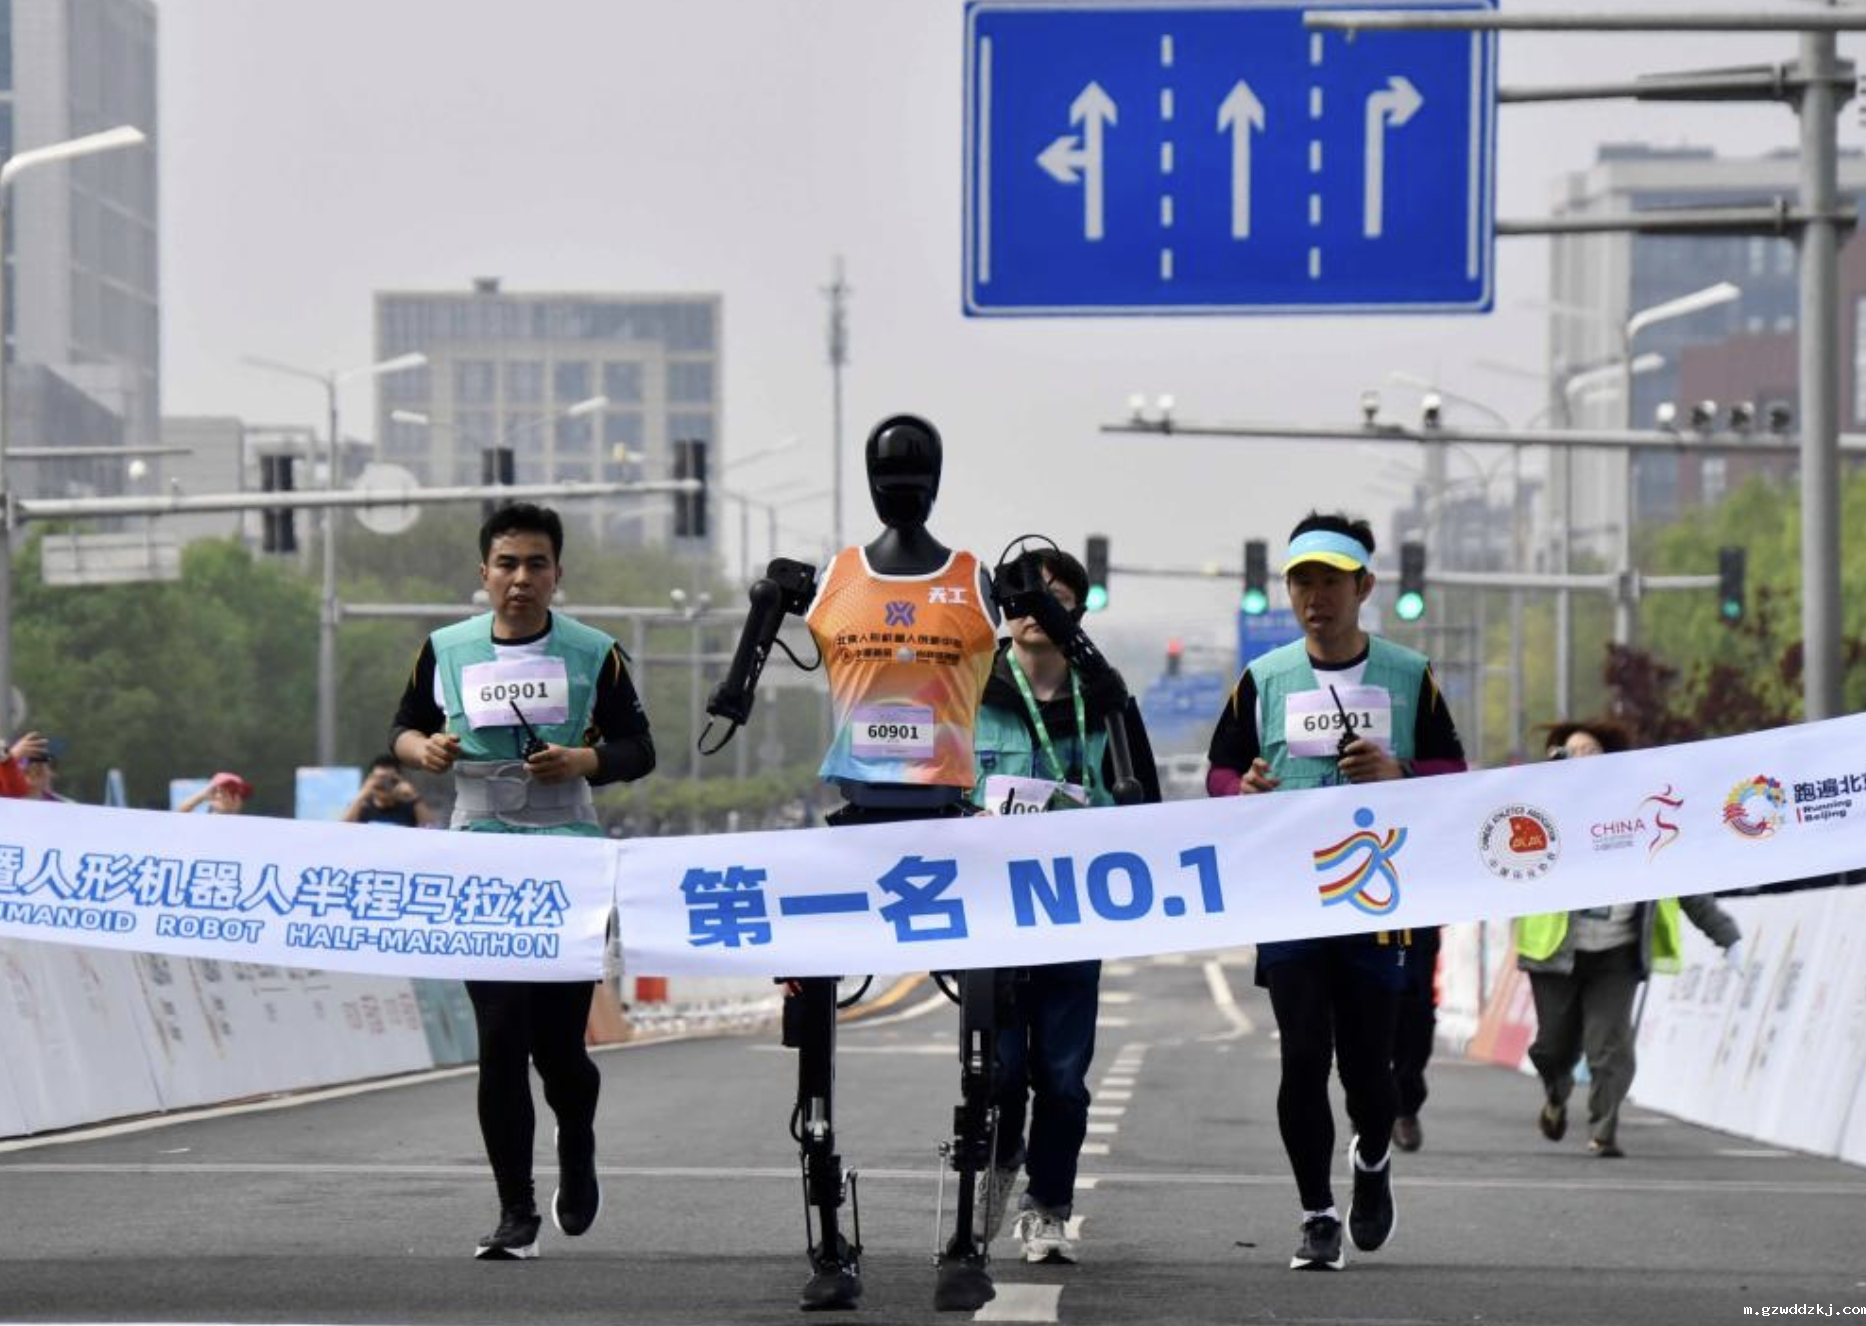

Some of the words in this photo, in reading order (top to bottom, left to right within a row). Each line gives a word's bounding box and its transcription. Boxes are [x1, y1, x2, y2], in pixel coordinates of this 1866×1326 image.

[481, 682, 549, 702] 60901
[1304, 712, 1373, 731] 60901
[868, 725, 919, 740] 60901
[1794, 773, 1866, 803] 跑遍北
[1591, 818, 1646, 837] CHINA
[680, 856, 968, 948] 第一名
[1008, 845, 1226, 927] NO.1
[0, 901, 137, 933] MANOID
[157, 913, 265, 945] ROBOT
[286, 923, 560, 959] HALF-MARATHON
